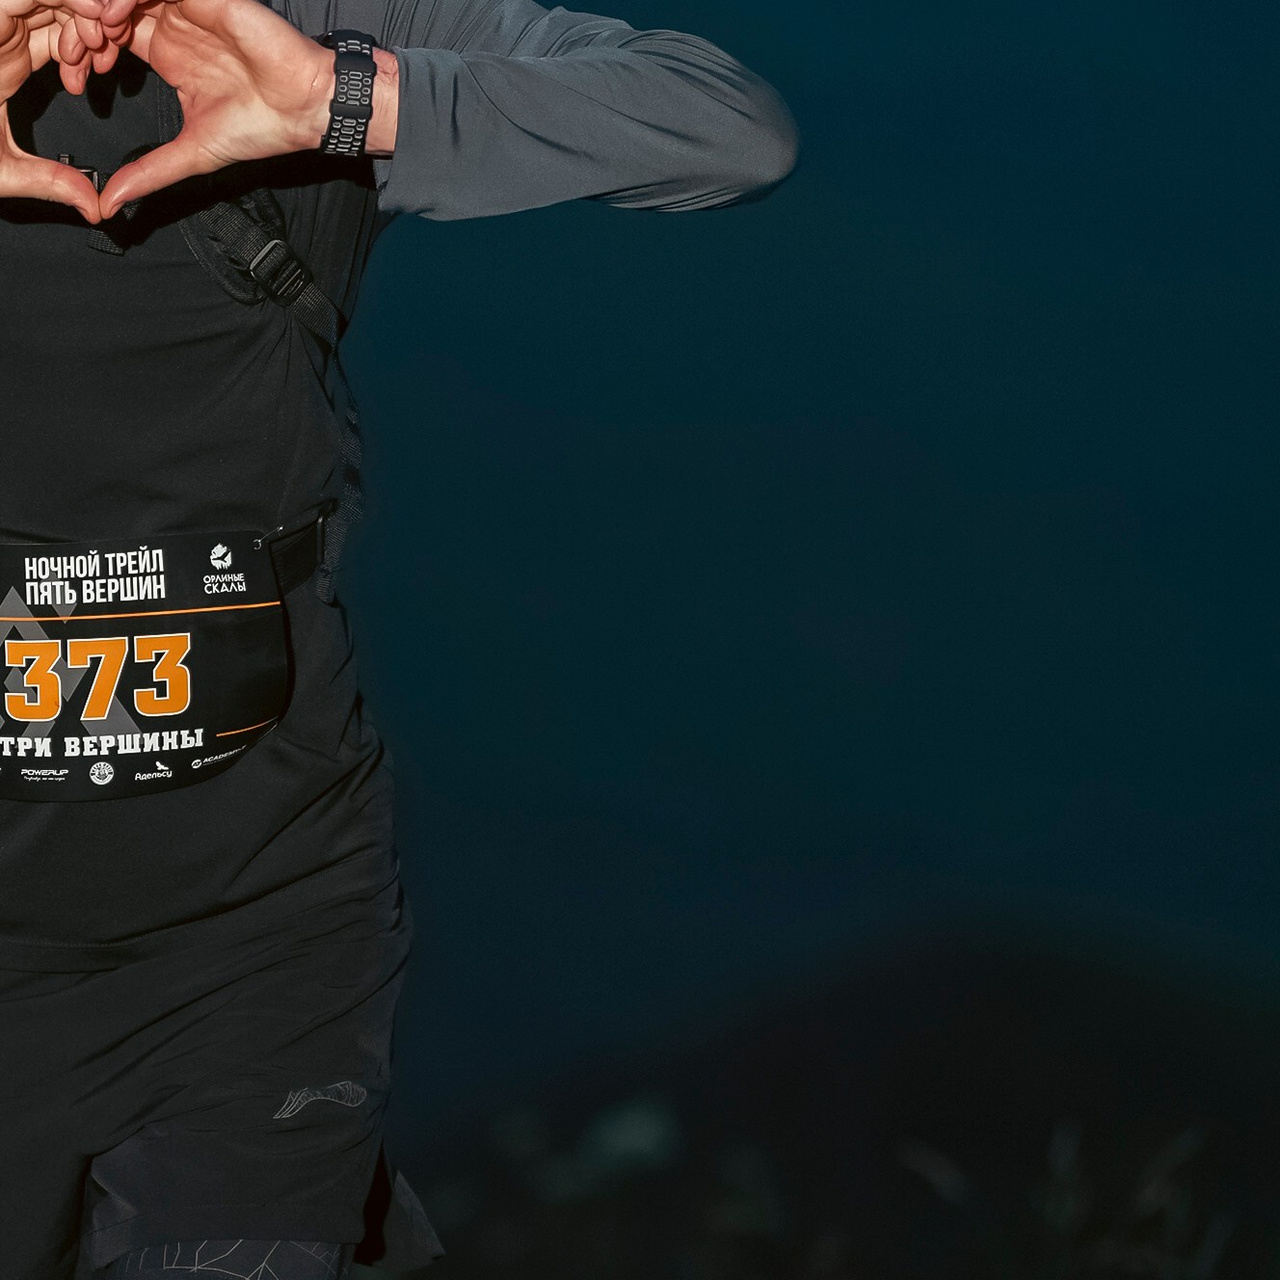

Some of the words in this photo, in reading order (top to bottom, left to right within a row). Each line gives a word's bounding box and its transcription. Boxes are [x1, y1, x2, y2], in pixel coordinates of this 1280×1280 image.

[24, 549, 100, 580] НОЧНОЙ
[104, 545, 165, 576] ТРЕЙЛ
[25, 580, 77, 606] ПЯТЬ
[81, 574, 166, 604] ВЕРШИН
[203, 573, 245, 584] ОРЛИНЫЕ
[204, 581, 247, 595] СКАЛЫ
[4, 632, 191, 722] 373
[64, 728, 204, 757] ВЕРШИНЫ
